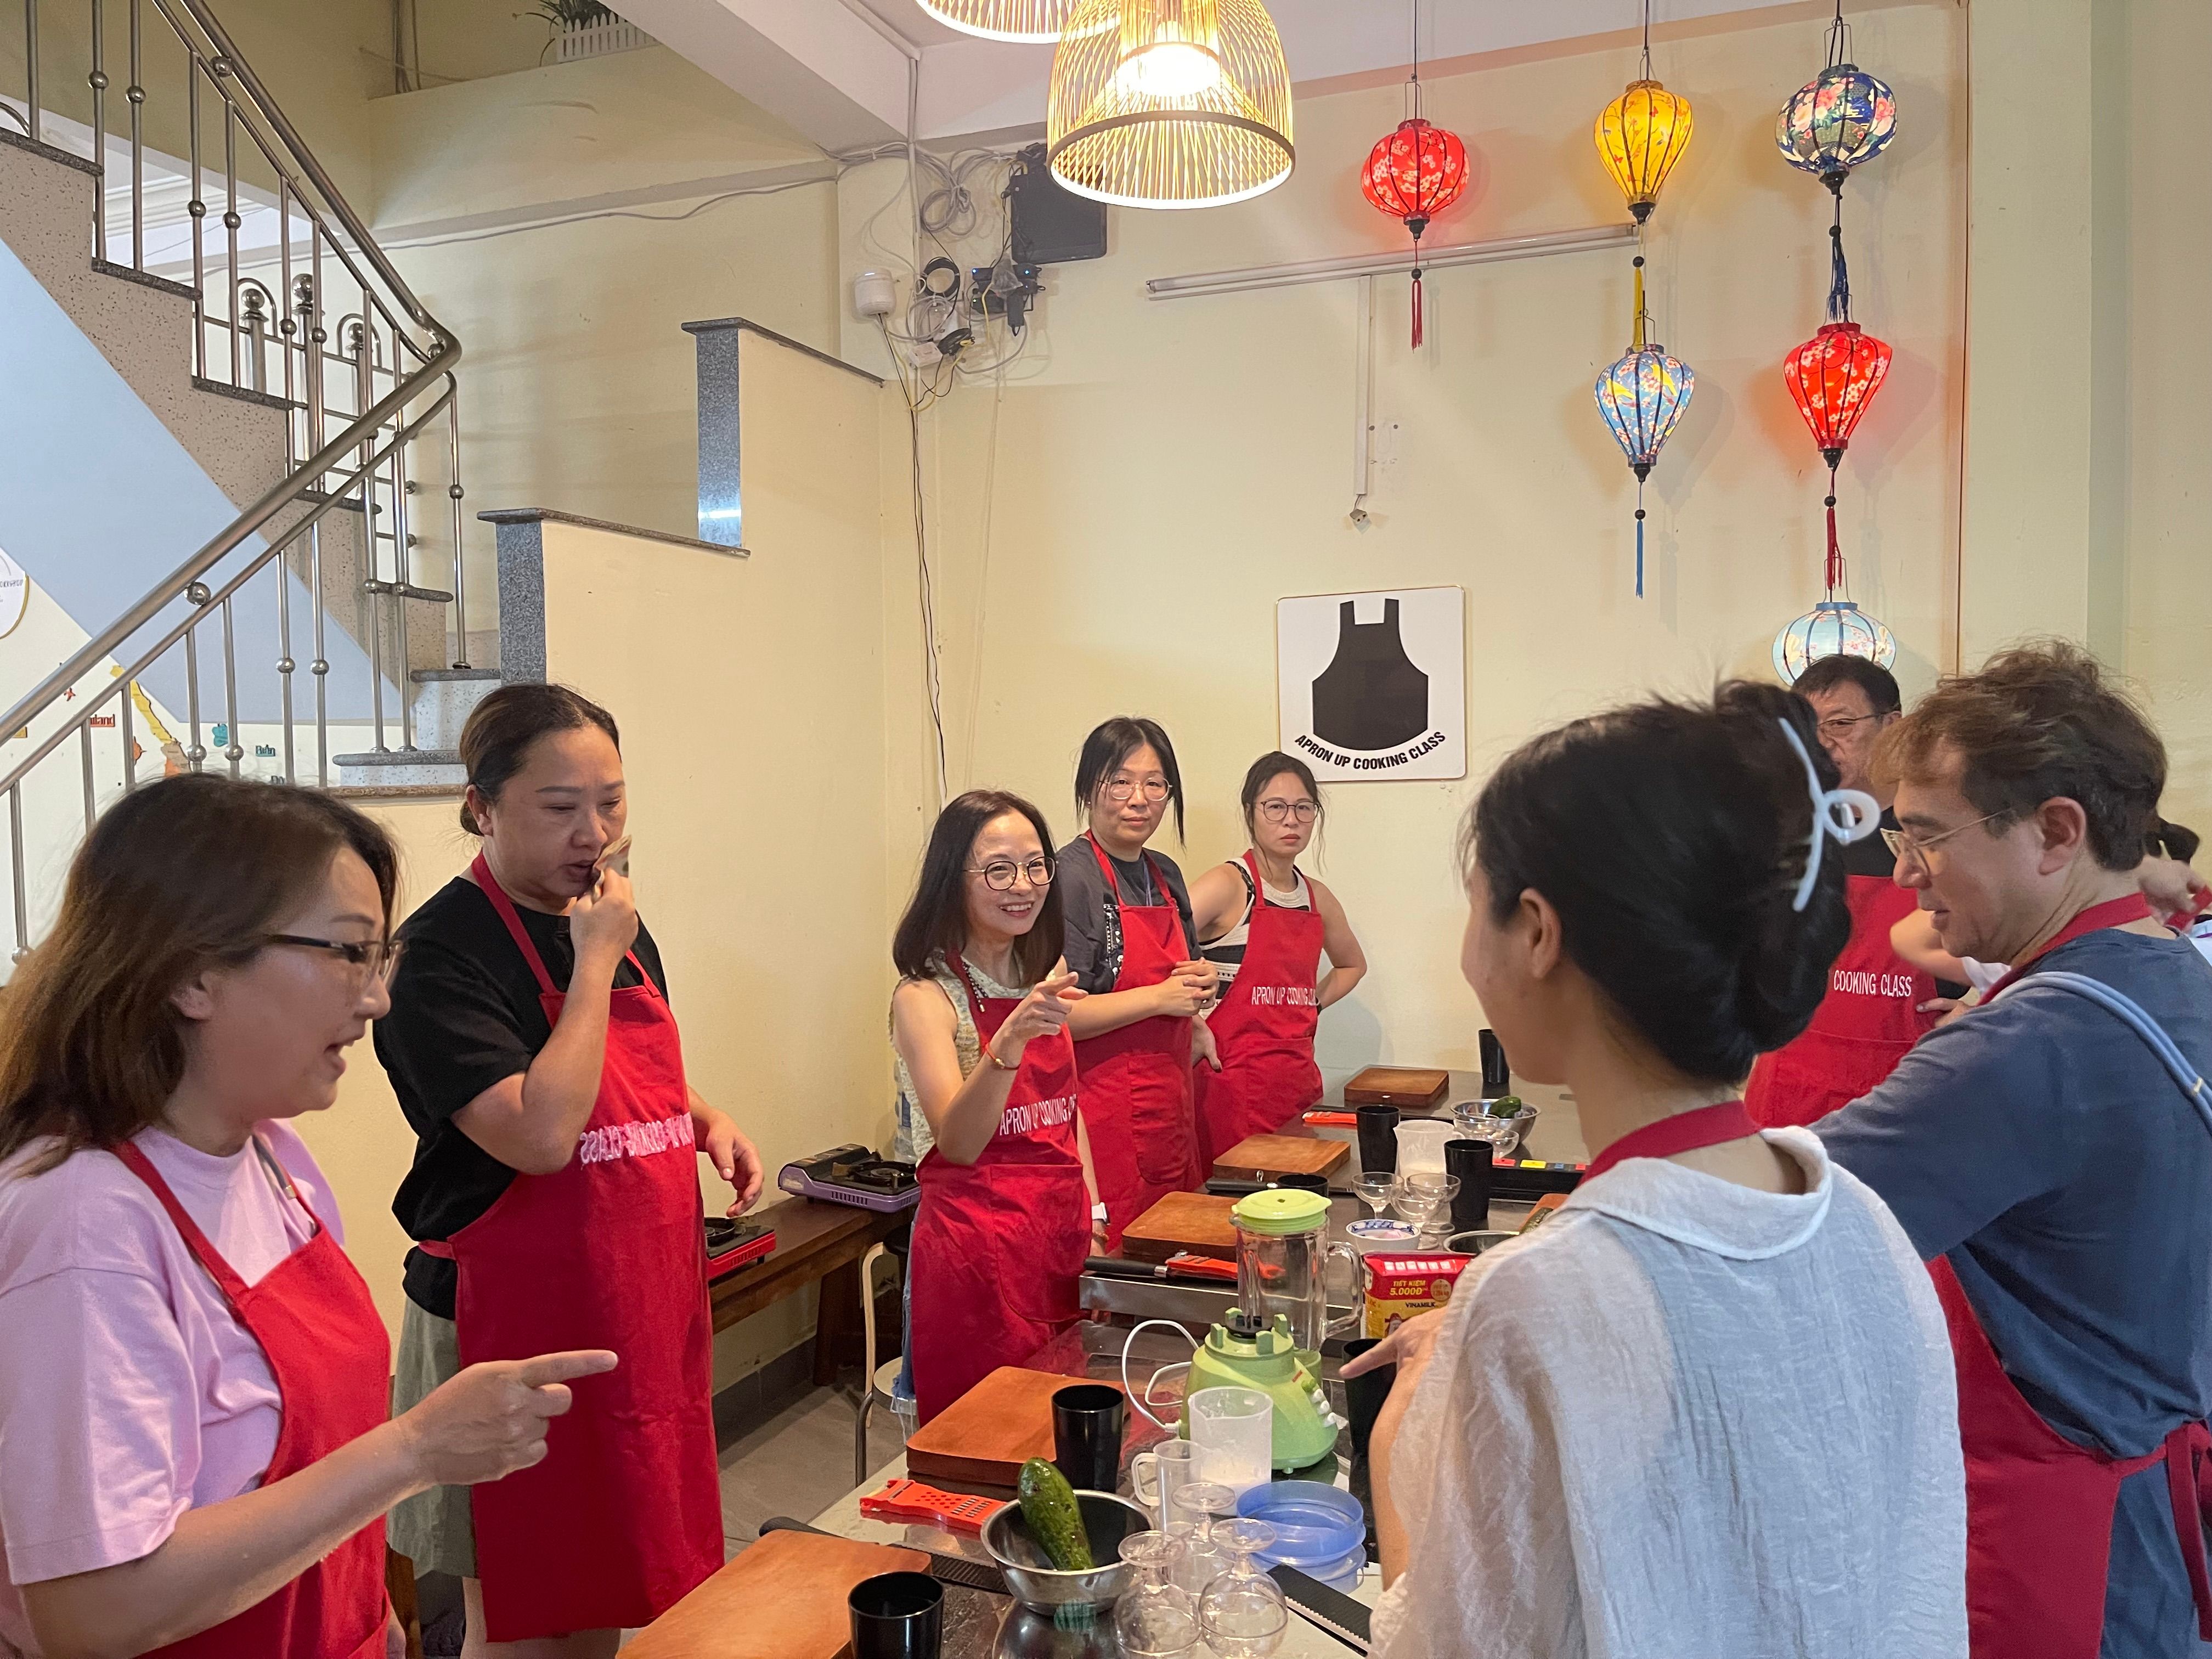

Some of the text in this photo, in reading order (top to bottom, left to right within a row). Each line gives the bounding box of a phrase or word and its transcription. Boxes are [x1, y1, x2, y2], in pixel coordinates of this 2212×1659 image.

[1294, 731, 1446, 770] APRON UP COOKING CLASS
[1251, 986, 1276, 1005] APRON
[1833, 969, 1912, 997] COOKING CLASS
[1000, 1104, 1032, 1136] APRON
